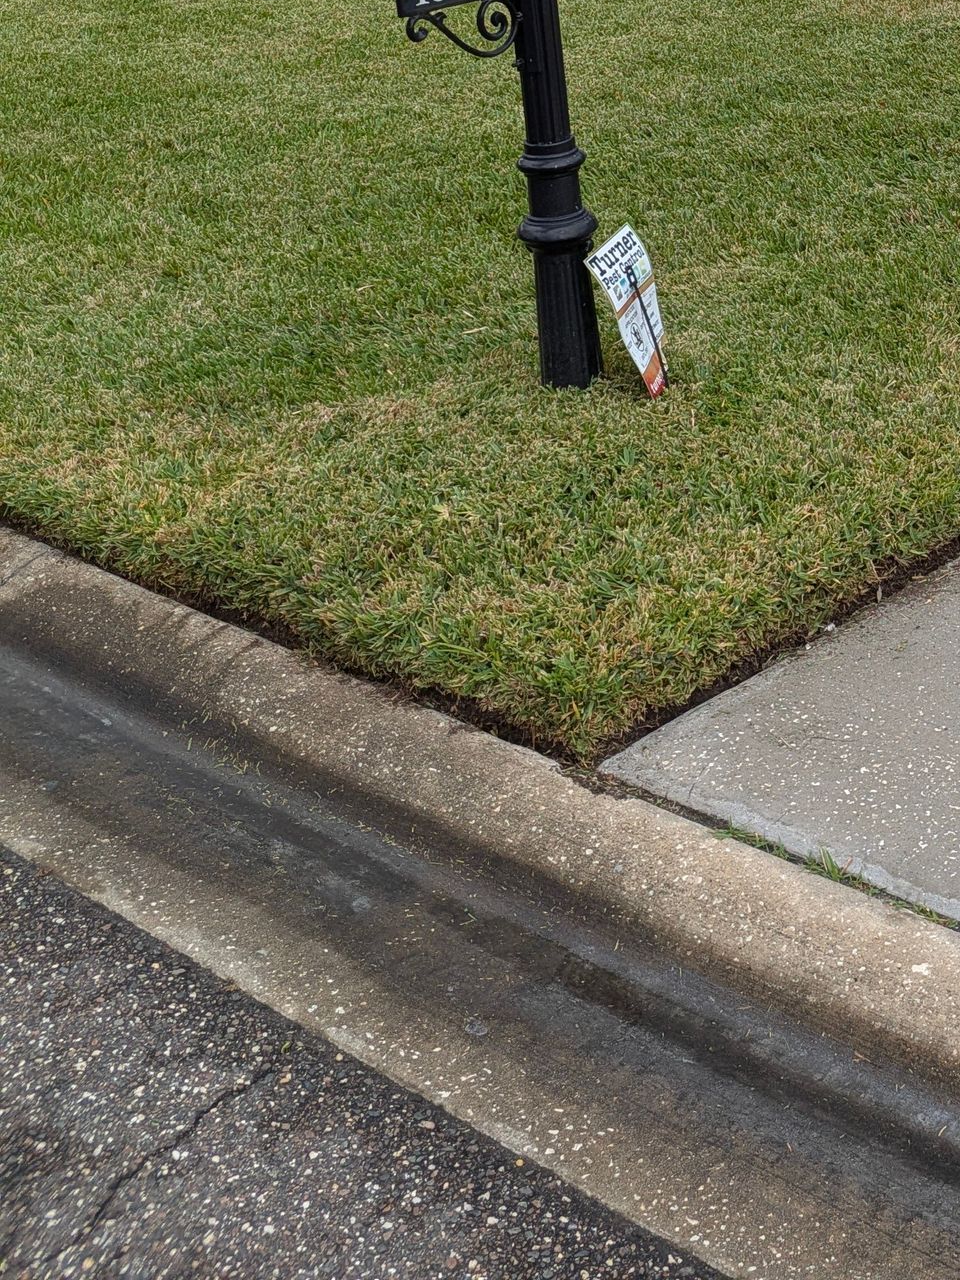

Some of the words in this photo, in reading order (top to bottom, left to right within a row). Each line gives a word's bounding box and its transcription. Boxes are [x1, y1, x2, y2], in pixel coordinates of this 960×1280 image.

[588, 230, 637, 277] Turner
[602, 269, 621, 290] Pest
[619, 246, 645, 274] Control
